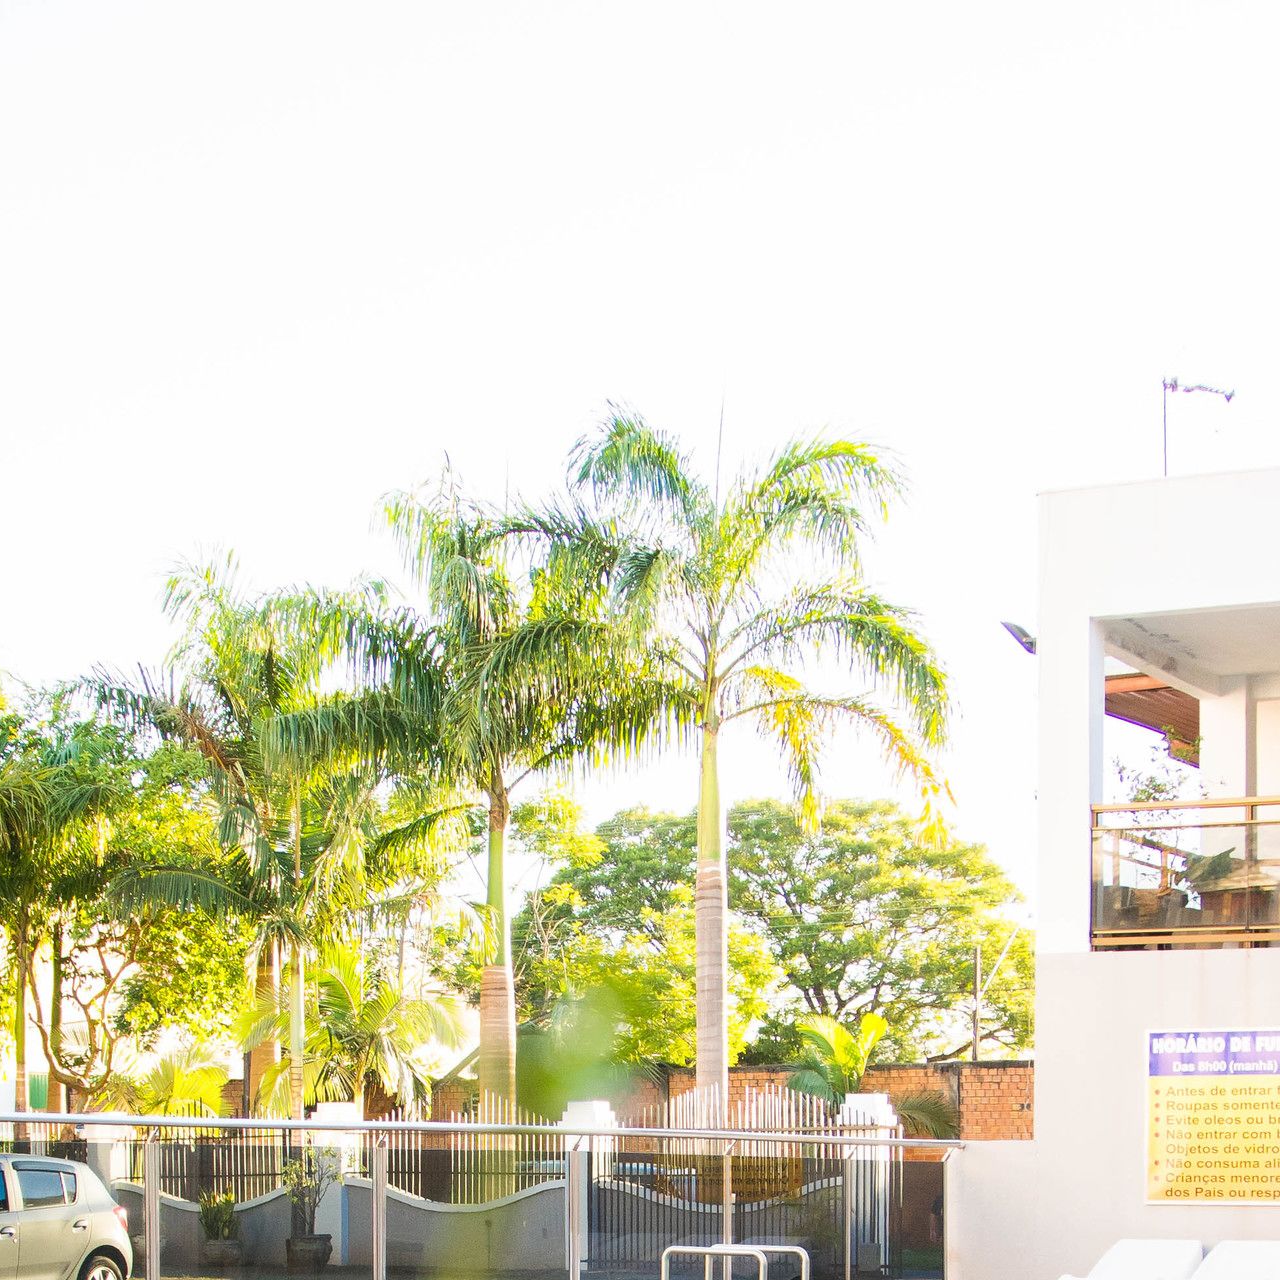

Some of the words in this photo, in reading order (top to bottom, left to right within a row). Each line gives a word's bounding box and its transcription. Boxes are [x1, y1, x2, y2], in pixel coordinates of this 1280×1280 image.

[1152, 1033, 1226, 1054] HORÁRIO
[1229, 1036, 1252, 1053] DE
[1172, 1061, 1196, 1072] Das
[1166, 1086, 1205, 1097] Antes
[1210, 1085, 1226, 1096] de
[1231, 1086, 1271, 1096] entrar
[1166, 1101, 1218, 1113] Roupas
[1166, 1114, 1199, 1125] Evite
[1246, 1116, 1264, 1125] ou
[1166, 1129, 1192, 1140] Não
[1196, 1130, 1238, 1140] entrar
[1242, 1131, 1271, 1140] com
[1166, 1143, 1219, 1156] Objetos
[1223, 1144, 1240, 1154] de
[1166, 1157, 1192, 1169] Não
[1196, 1160, 1260, 1169] consuma
[1165, 1172, 1226, 1184] Crianças
[1165, 1187, 1190, 1197] dos
[1195, 1187, 1225, 1197] Pais
[1229, 1188, 1246, 1197] ou
